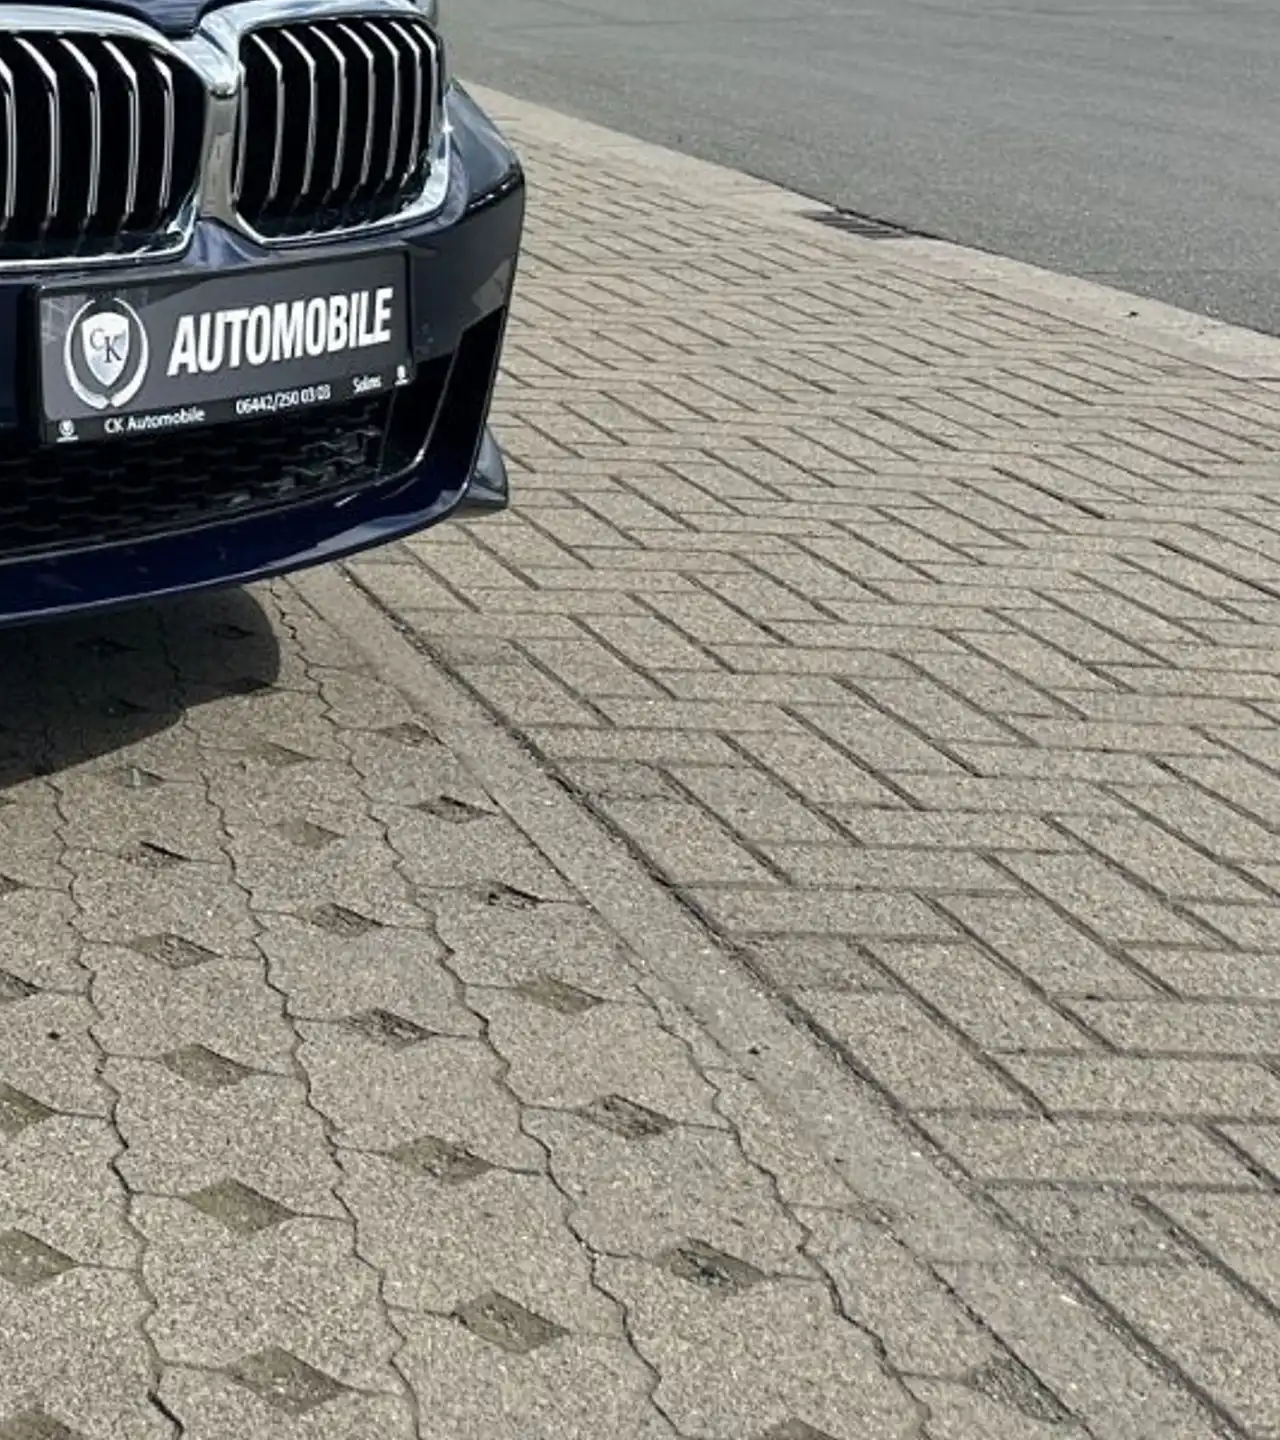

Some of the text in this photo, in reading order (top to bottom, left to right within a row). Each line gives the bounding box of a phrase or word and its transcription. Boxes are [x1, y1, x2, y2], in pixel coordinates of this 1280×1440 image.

[167, 286, 394, 377] AUTOMOBILE
[235, 389, 299, 415] 06442/250
[301, 386, 316, 404] 03
[103, 406, 206, 434] CK Automobile
